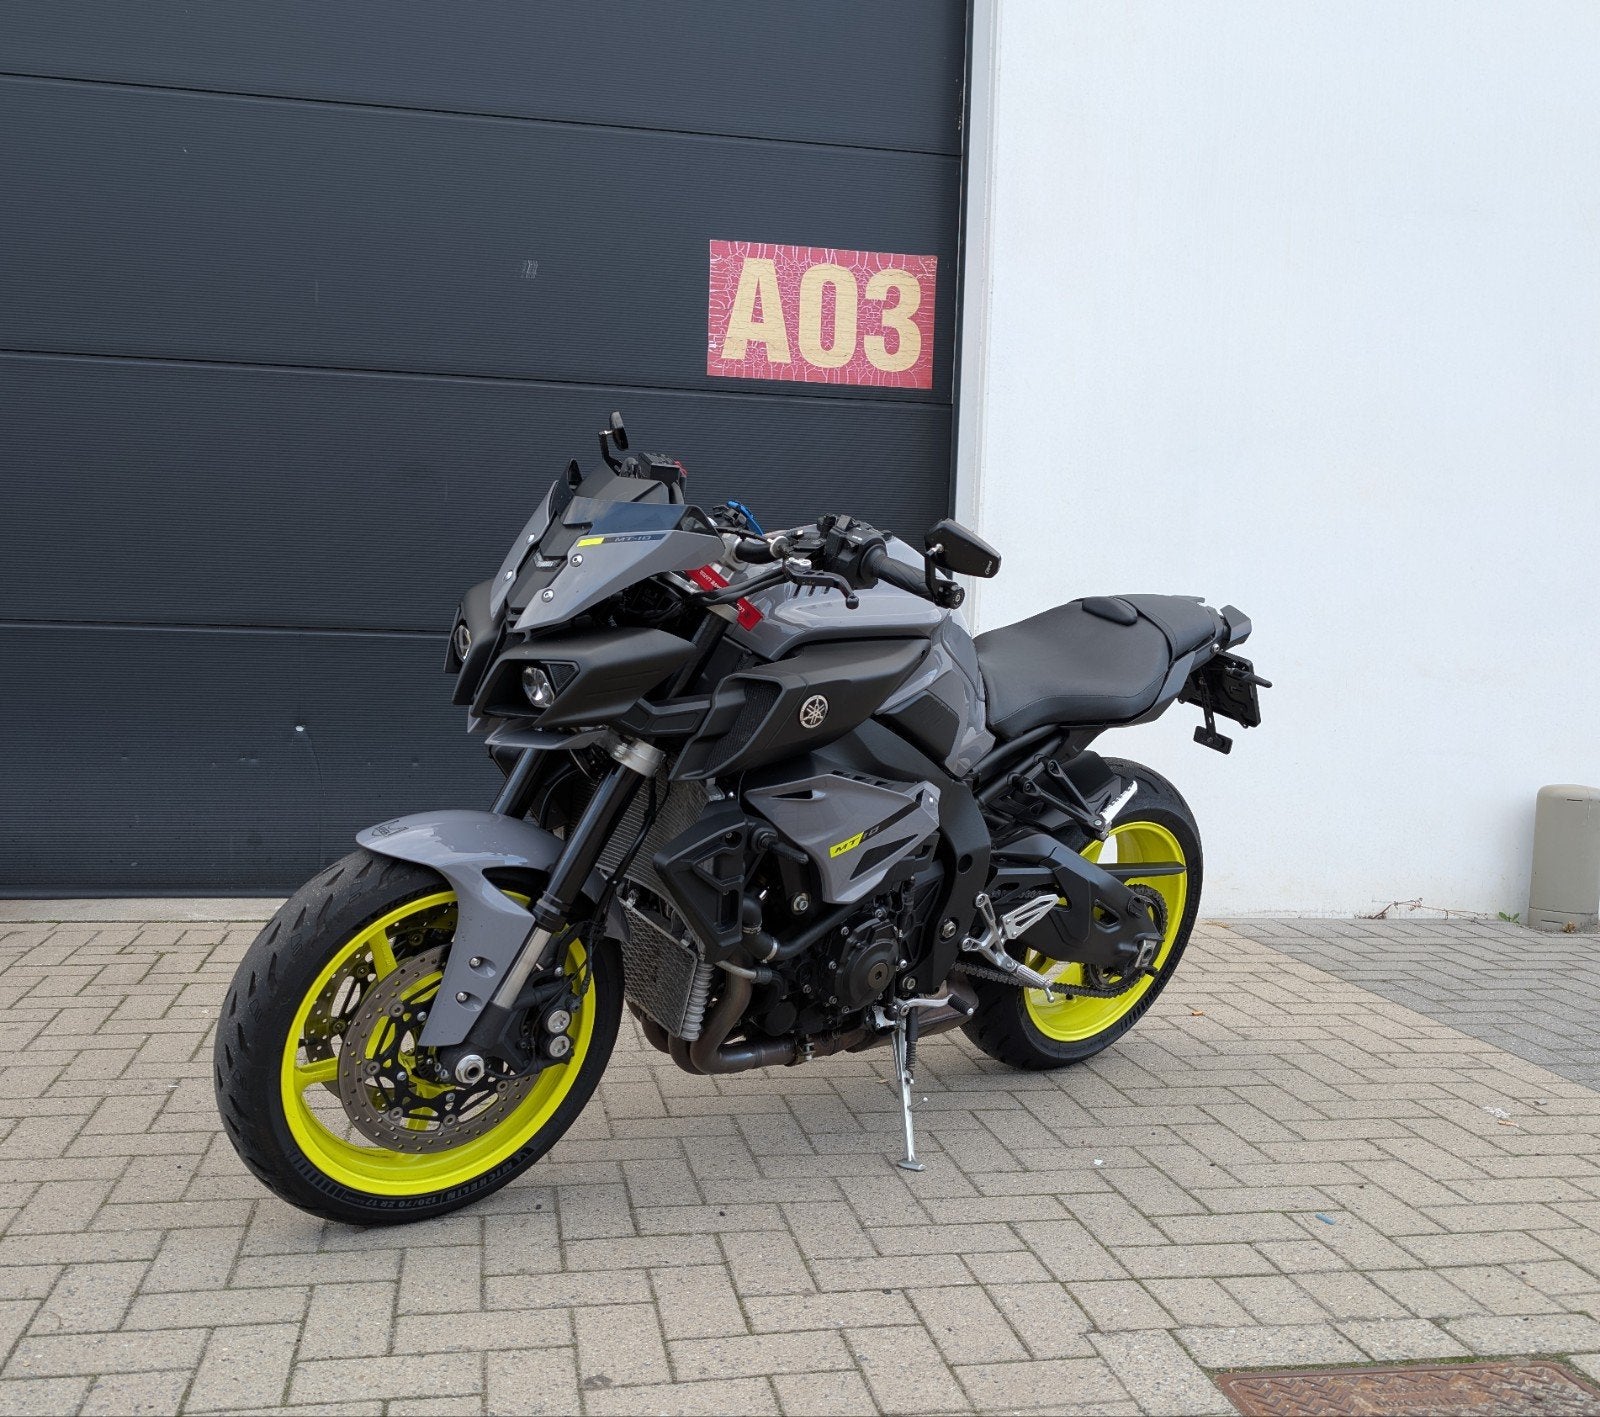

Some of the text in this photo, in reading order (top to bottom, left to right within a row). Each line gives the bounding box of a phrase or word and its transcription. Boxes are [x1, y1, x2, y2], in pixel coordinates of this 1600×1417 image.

[720, 257, 922, 373] A03
[446, 1161, 514, 1201] MICHELIN
[380, 1200, 397, 1208] ZR
[398, 1196, 437, 1208] 120/70
